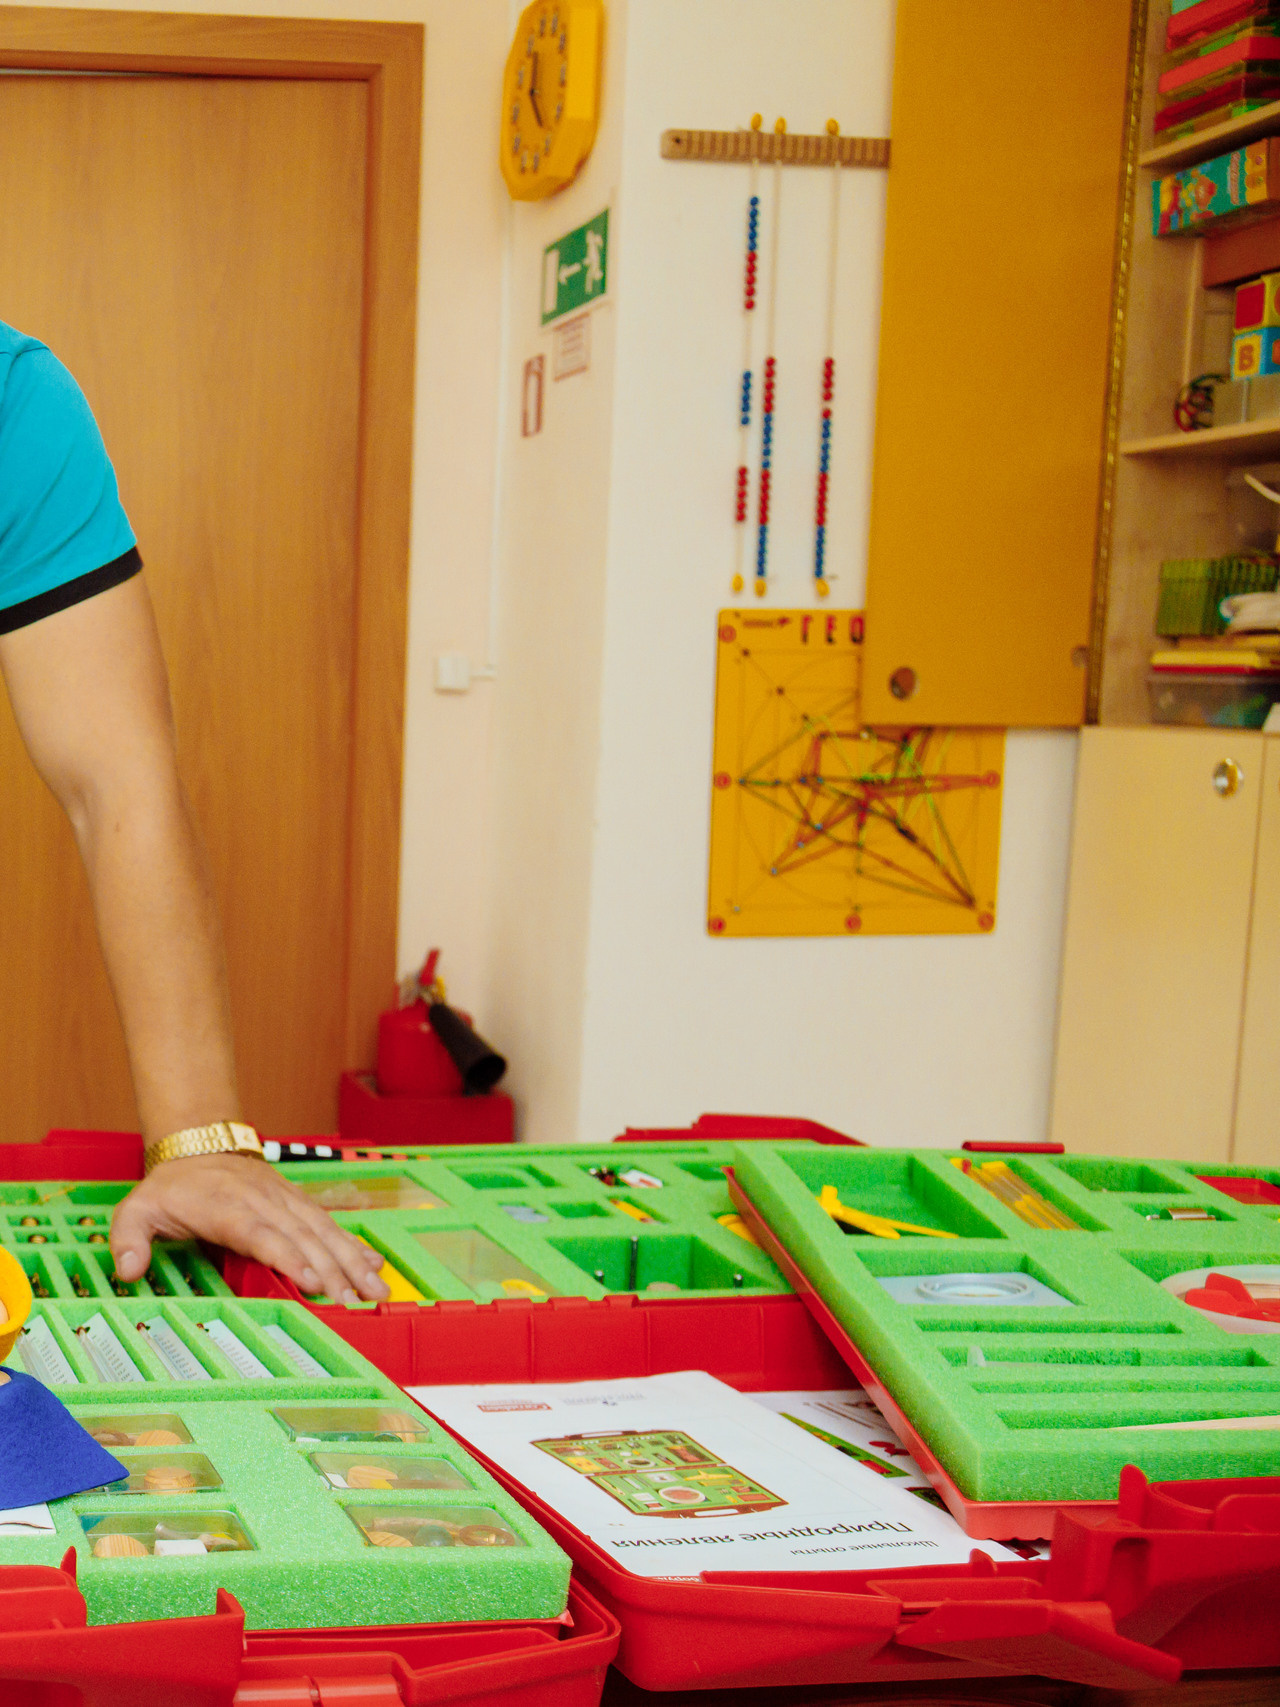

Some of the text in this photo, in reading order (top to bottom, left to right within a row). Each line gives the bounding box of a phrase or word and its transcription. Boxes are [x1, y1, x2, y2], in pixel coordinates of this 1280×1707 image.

[610, 1519, 914, 1548] Природные явления
[790, 1540, 940, 1556] Школьные опыты
